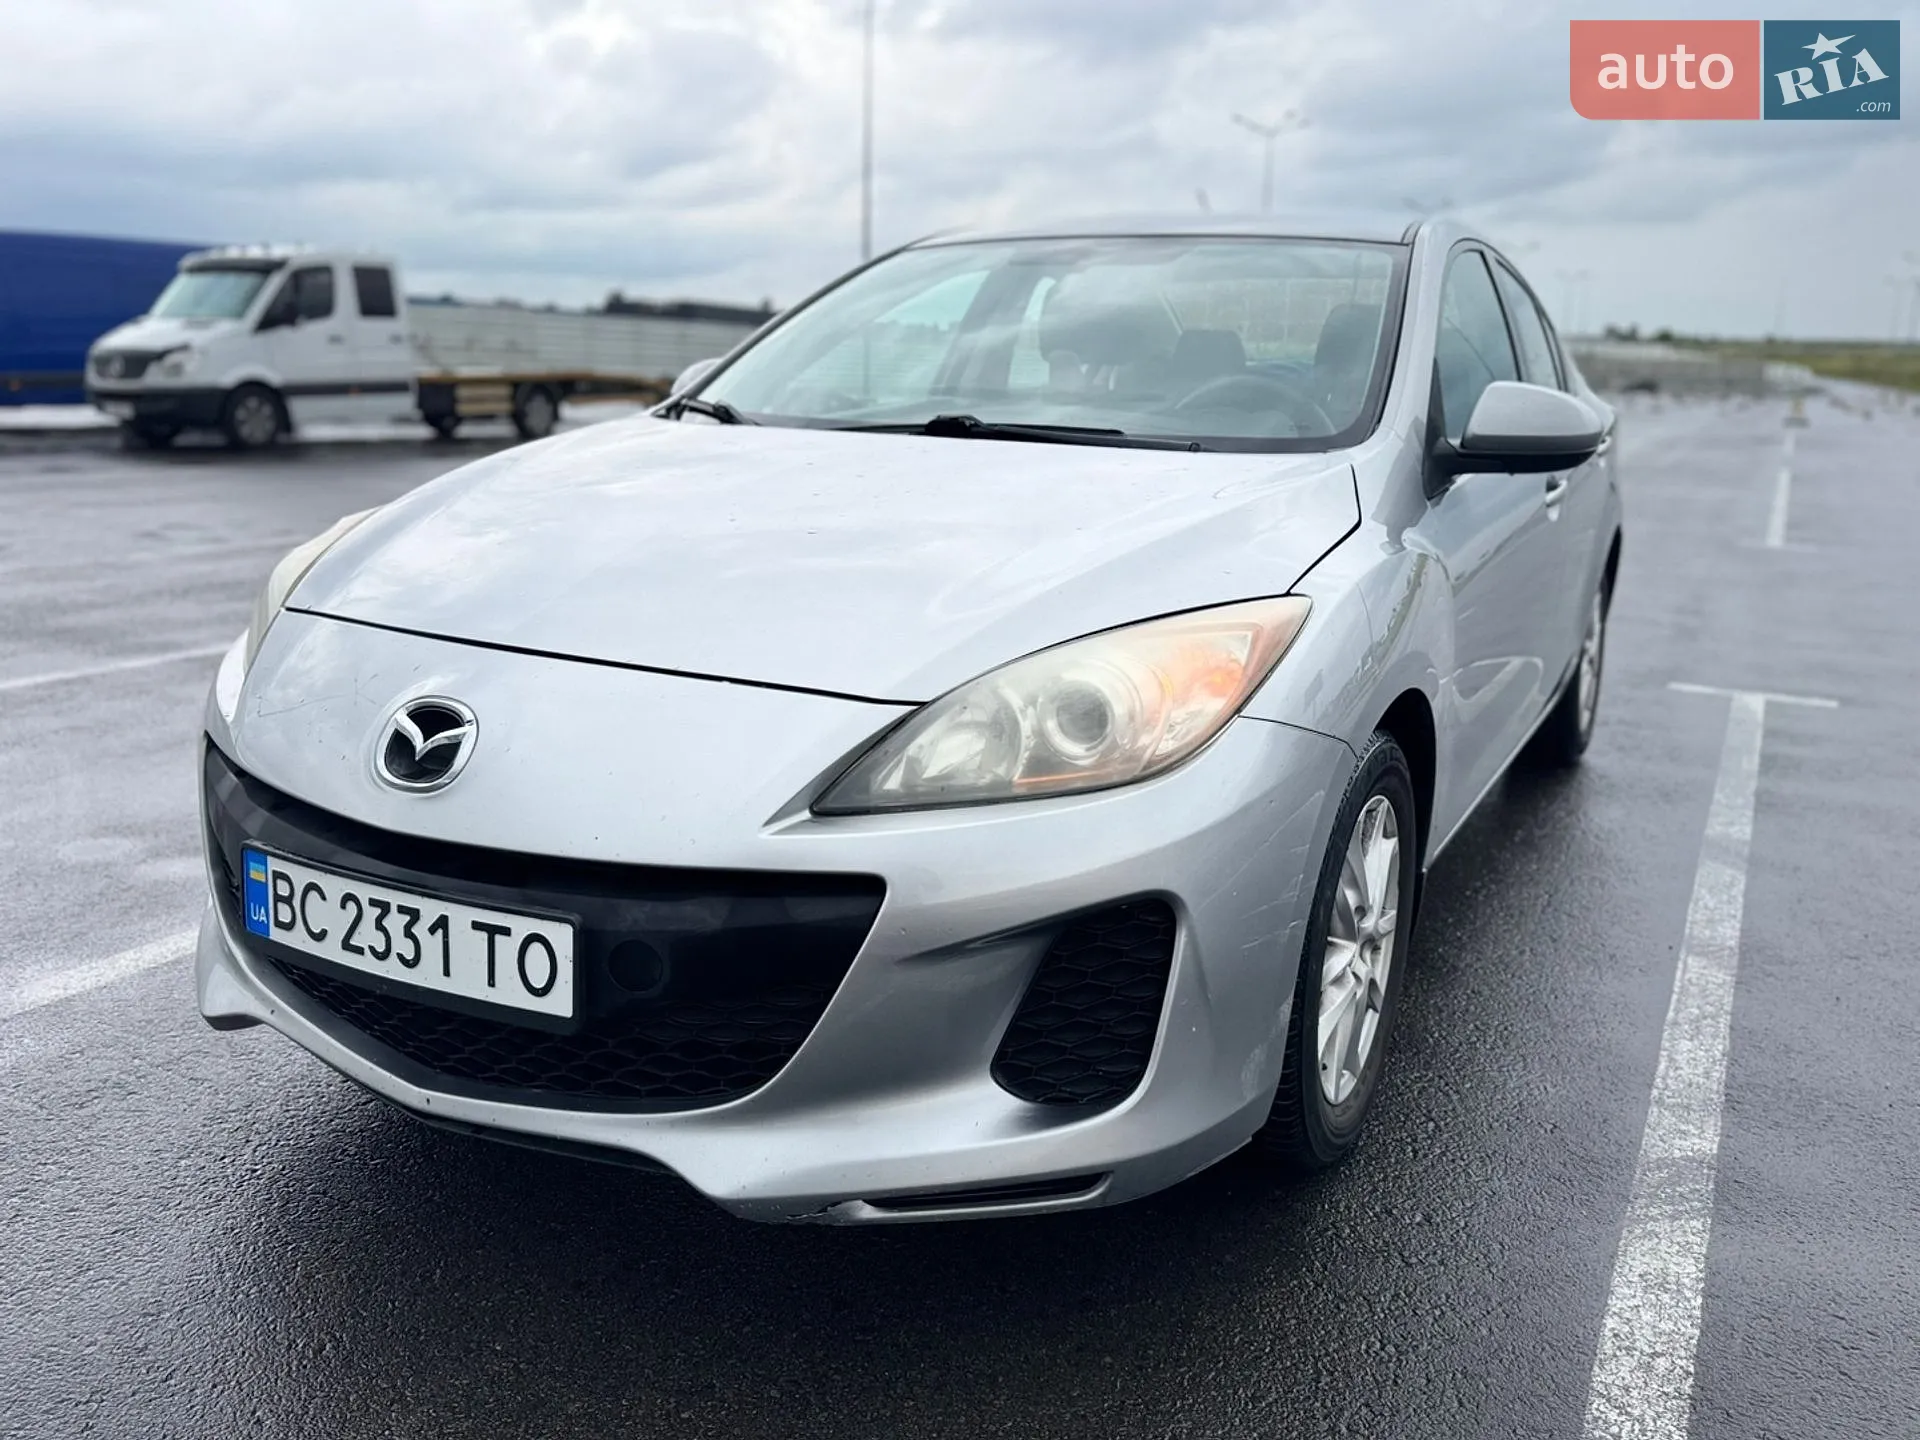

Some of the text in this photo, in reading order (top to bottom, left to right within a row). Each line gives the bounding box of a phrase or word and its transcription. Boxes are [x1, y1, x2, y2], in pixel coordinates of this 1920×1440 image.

[250, 902, 267, 925] UA
[272, 869, 558, 998] BC 2331 TO
